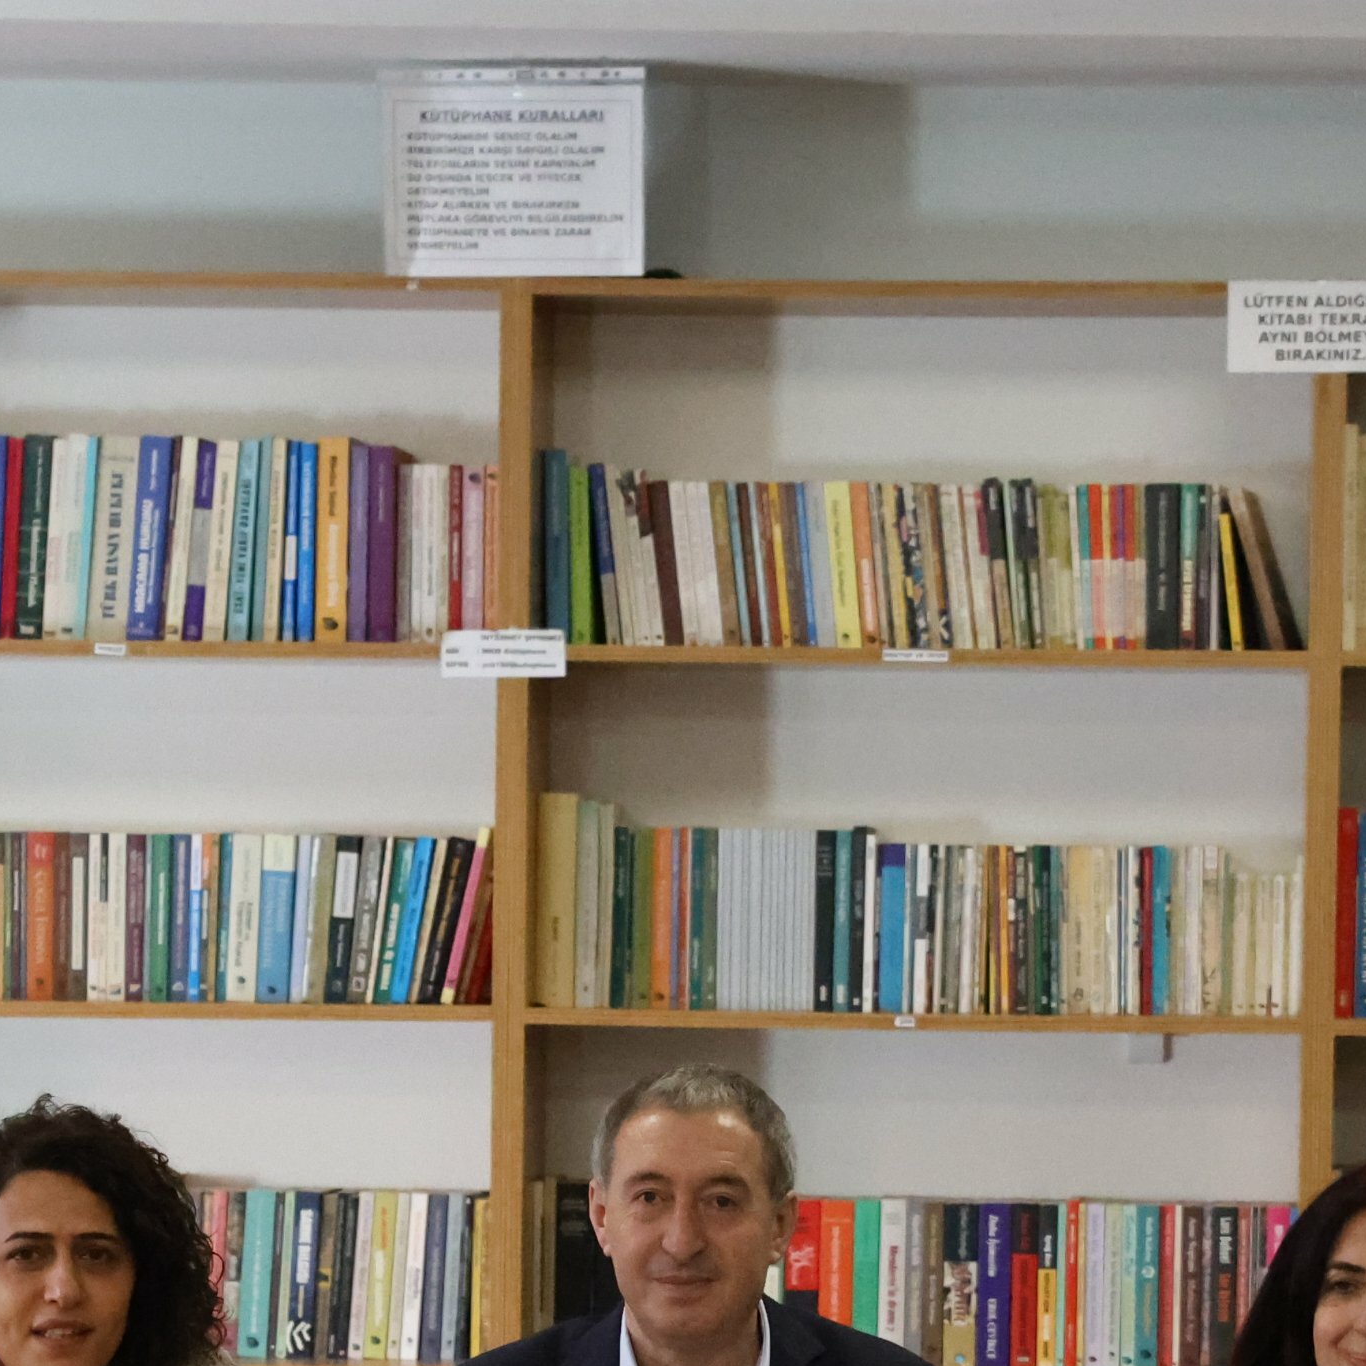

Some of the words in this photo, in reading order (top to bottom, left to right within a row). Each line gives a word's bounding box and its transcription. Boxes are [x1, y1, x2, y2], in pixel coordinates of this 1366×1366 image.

[419, 108, 512, 123] KÜTÜPHANE
[518, 108, 605, 123] KURALLARI
[1244, 293, 1308, 308] LÜTFEN
[1258, 312, 1312, 326] KİTABI
[1258, 331, 1297, 344] AYNI
